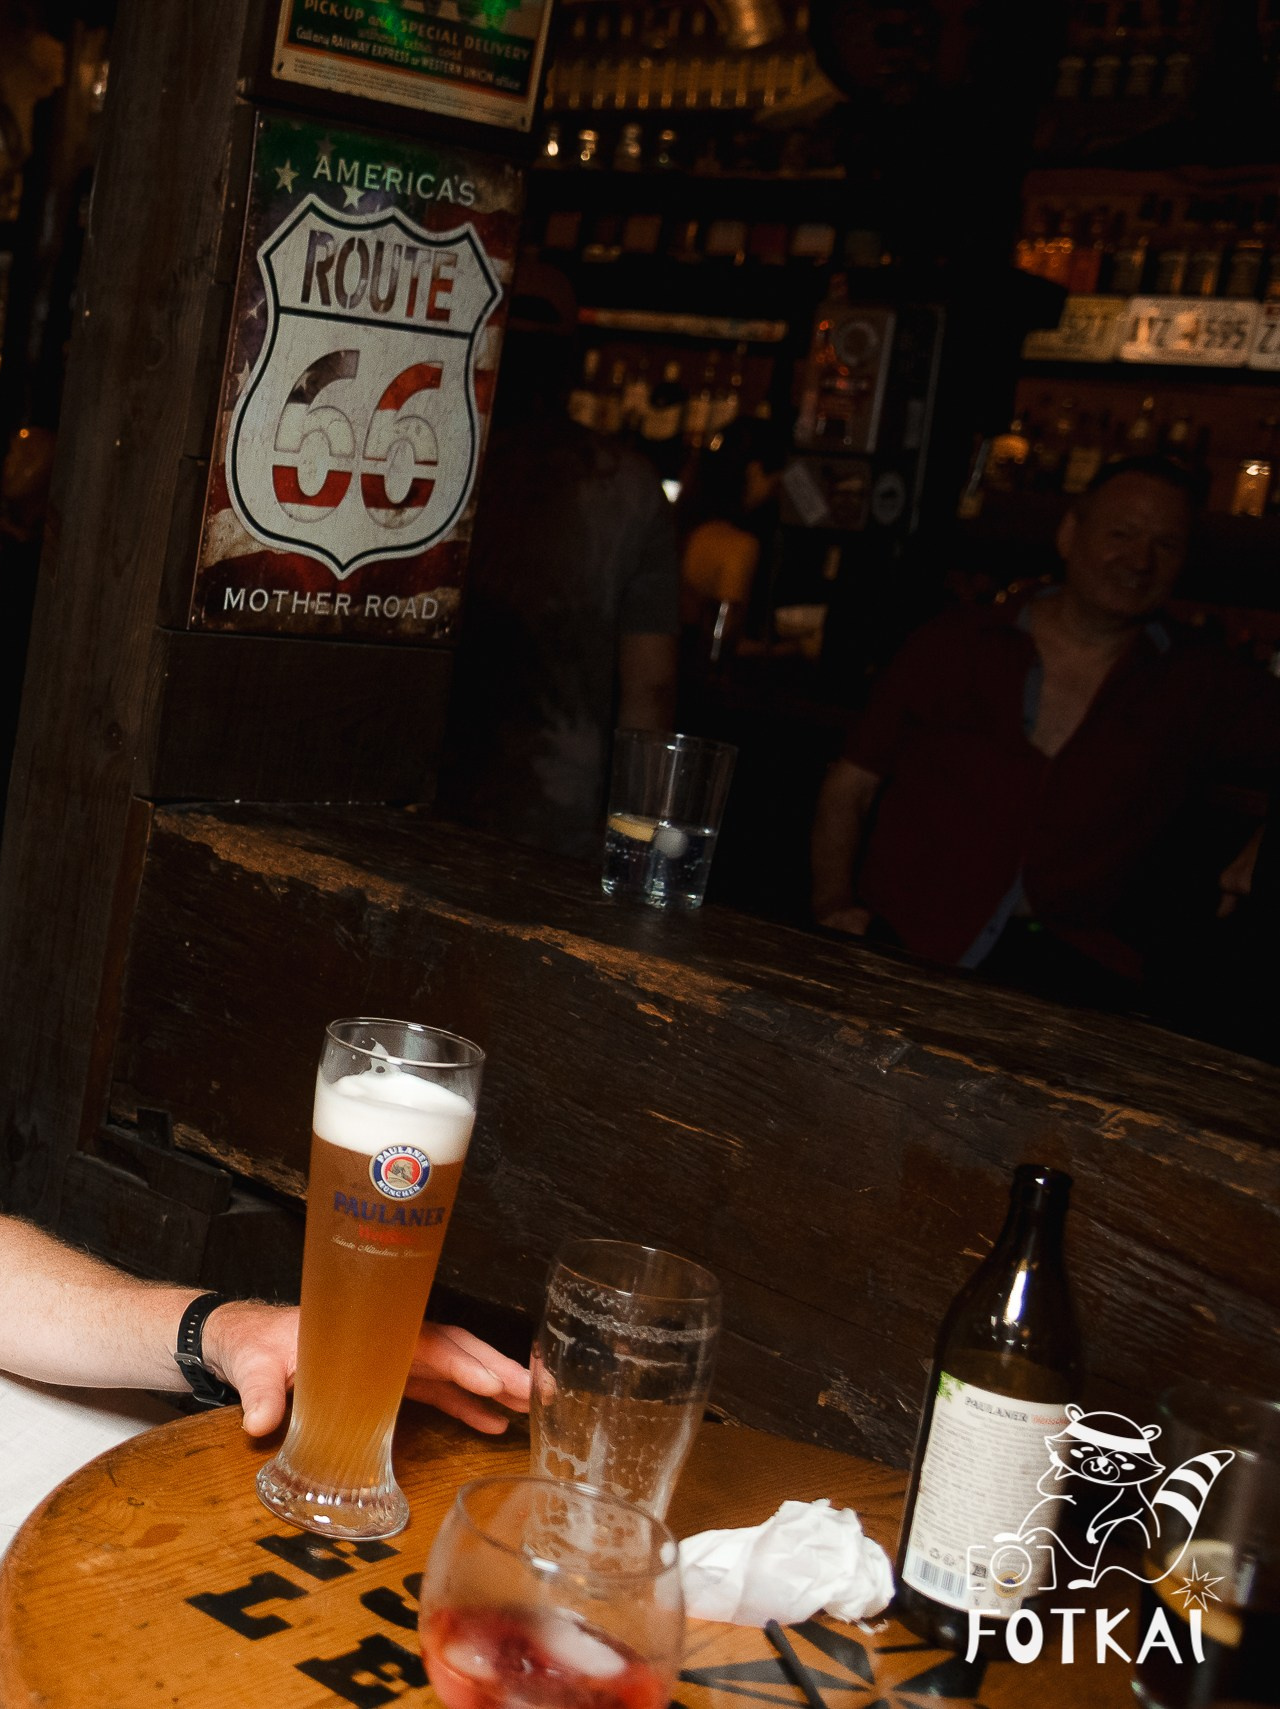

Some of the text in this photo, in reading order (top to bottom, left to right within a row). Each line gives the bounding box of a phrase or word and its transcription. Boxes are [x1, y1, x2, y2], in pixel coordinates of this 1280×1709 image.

[400, 18, 459, 49] SPECIAL
[463, 33, 530, 61] DELIVERY
[313, 155, 477, 207] AMERICA'S
[300, 228, 459, 323] ROUTE
[272, 349, 444, 530] 66
[223, 587, 440, 621] MOTHER ROAD
[376, 1145, 430, 1168] PAULANER
[333, 1190, 446, 1227] PAULANER
[965, 1396, 1028, 1423] PAULANER
